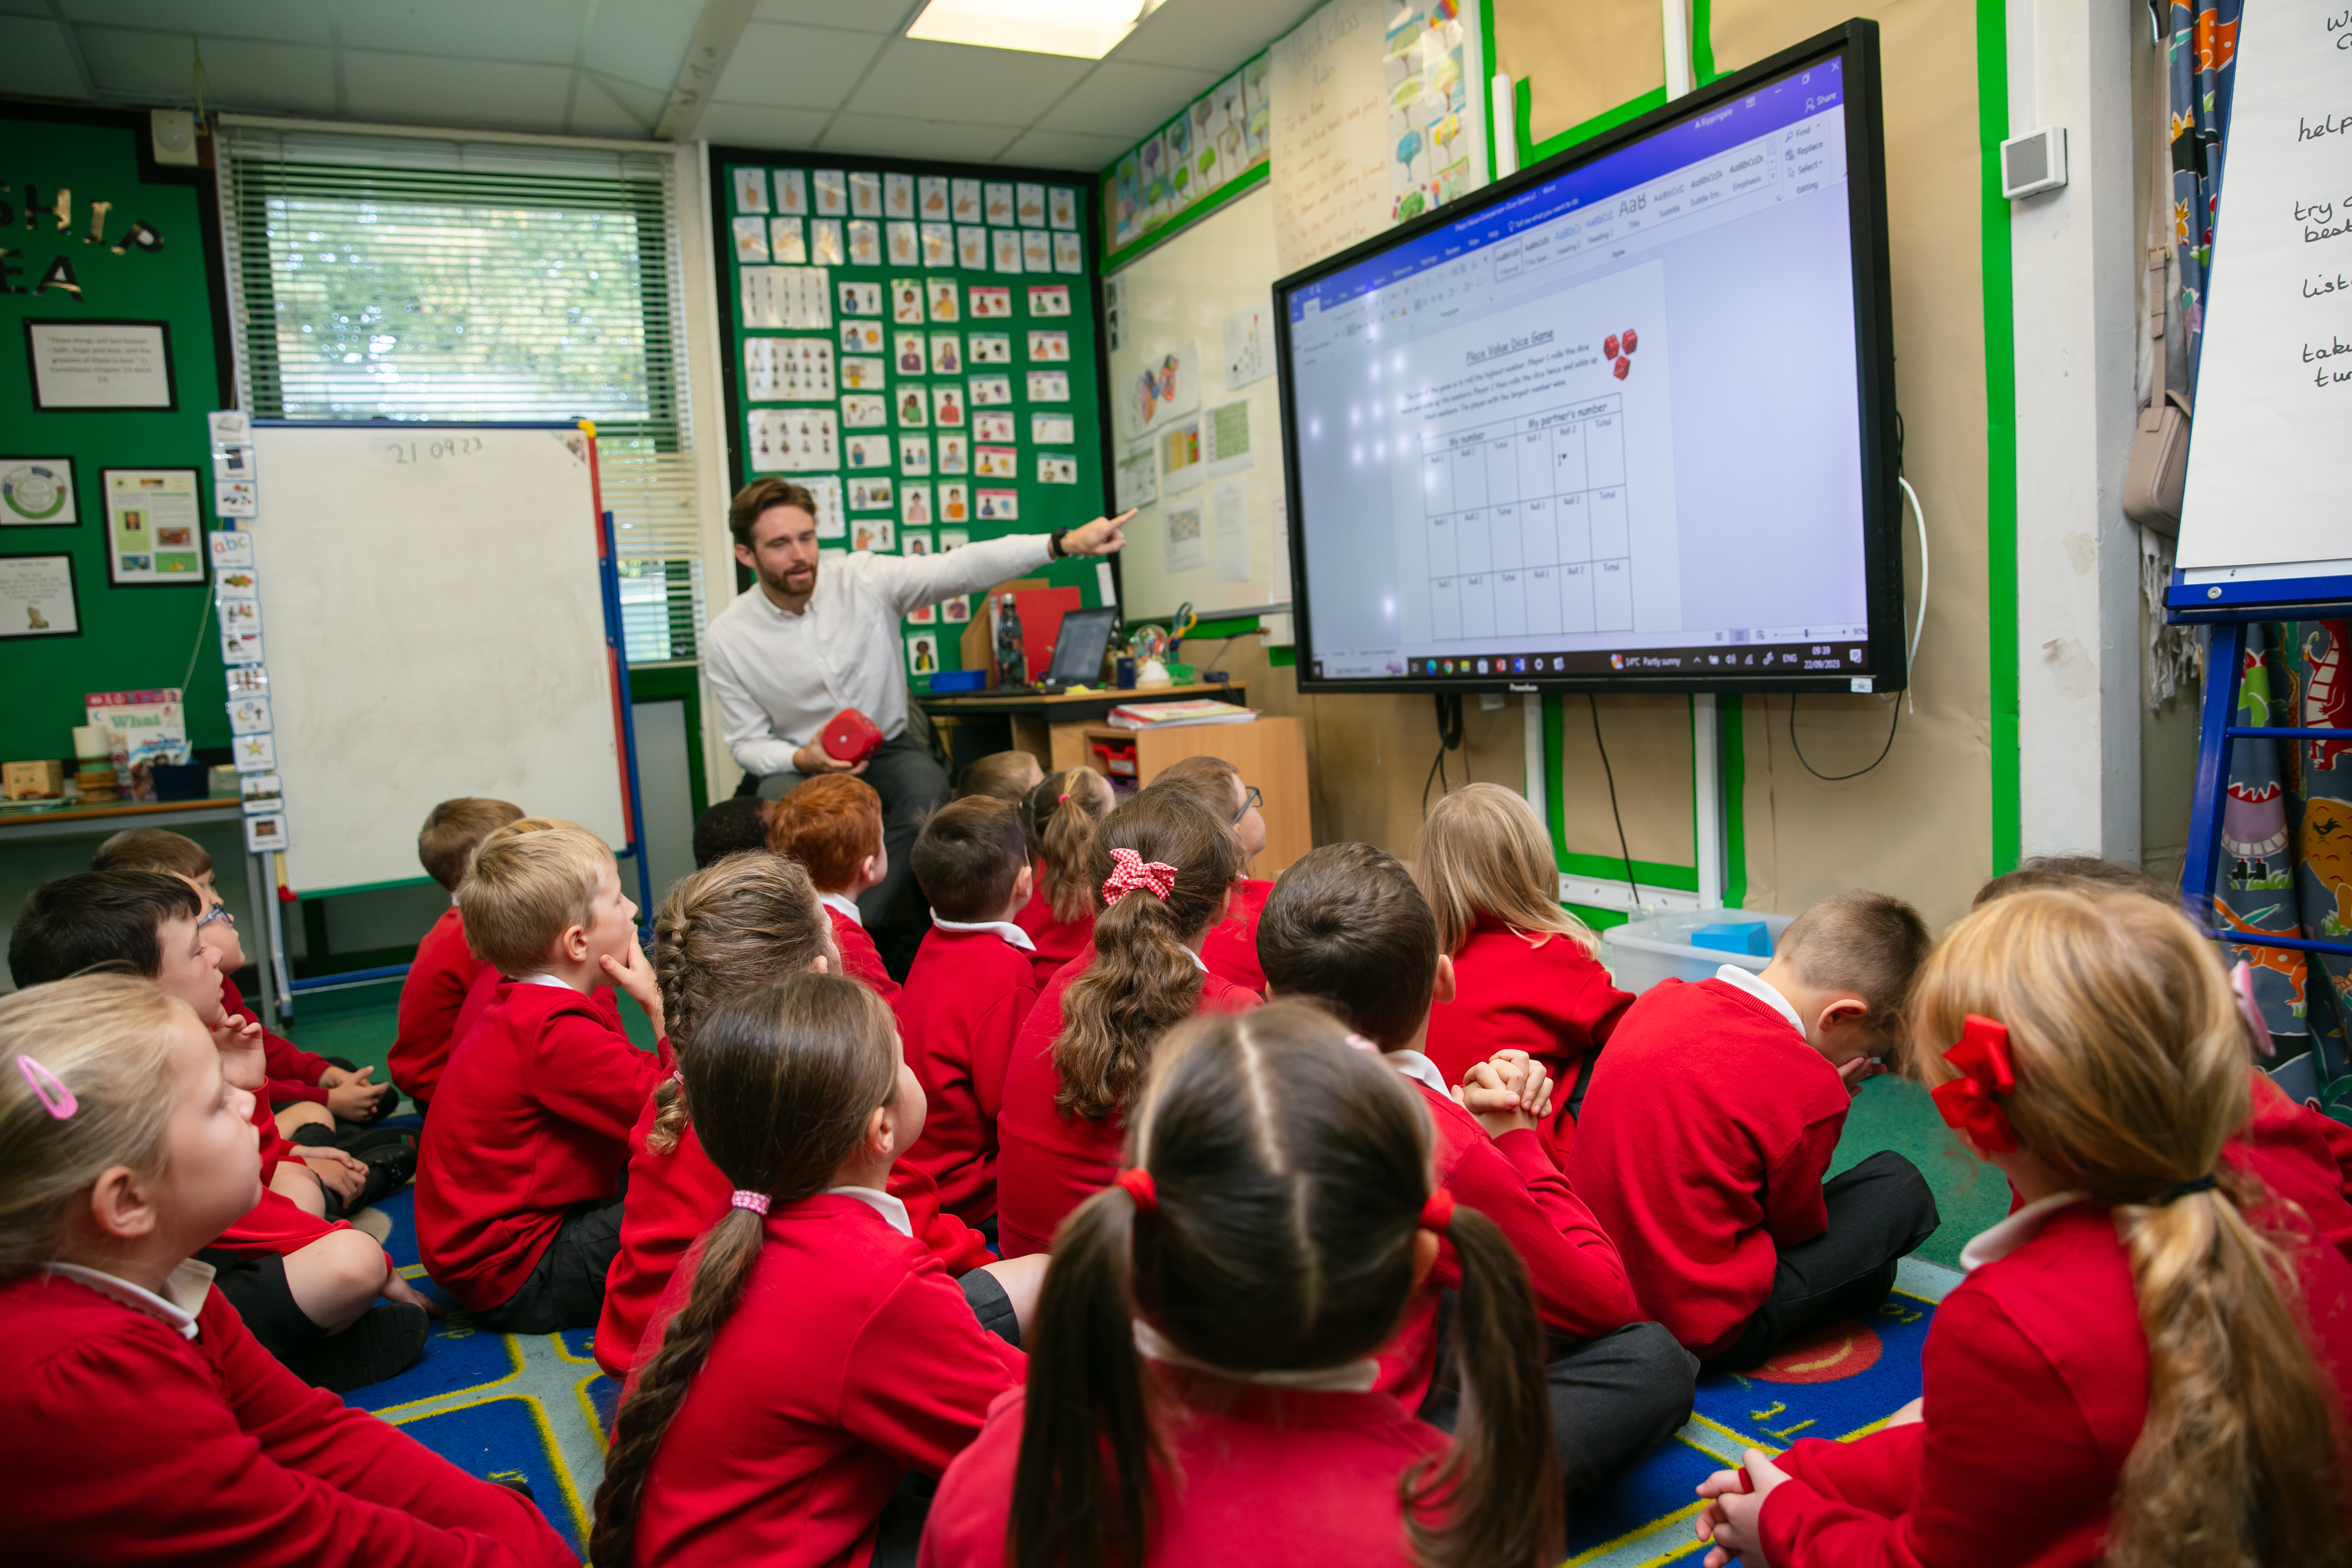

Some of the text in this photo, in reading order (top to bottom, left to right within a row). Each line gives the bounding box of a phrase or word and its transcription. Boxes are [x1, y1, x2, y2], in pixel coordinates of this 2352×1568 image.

[1817, 91, 1837, 106] Share
[1796, 125, 1811, 138] Find
[1796, 141, 1824, 156] Replace
[1798, 161, 1818, 175] Select
[1732, 175, 1761, 192] Emphasis
[1796, 181, 1818, 195] Editing
[1659, 205, 1680, 218] Subtitle
[2295, 201, 2332, 224] try
[2303, 274, 2352, 298] list
[1466, 329, 1554, 362] Place Value Dice Game
[1527, 356, 1545, 367] Player
[1550, 349, 1564, 359] rolls
[1565, 347, 1575, 356] the
[1576, 342, 1589, 353] dice
[1533, 370, 1545, 380] dice
[1546, 366, 1562, 375] twice
[1563, 360, 1574, 372] and
[1574, 358, 1589, 369] adds
[1590, 356, 1598, 367] up
[1510, 387, 1530, 400] largest
[1531, 382, 1551, 393] number
[1527, 402, 1608, 431] My partner's number
[1596, 416, 1612, 429] Total
[1560, 426, 1571, 436] Roll
[1449, 431, 1486, 449] My number
[1526, 434, 1538, 443] Roll
[1563, 496, 1575, 506] Roll
[1599, 489, 1616, 500] Total
[1530, 502, 1541, 511] Roll
[213, 536, 248, 554] abc
[1534, 569, 1545, 578] Roll
[1568, 566, 1579, 575] Roll
[1603, 561, 1620, 572] Total
[1642, 656, 1661, 669] Partly
[1661, 658, 1681, 668] sunny
[1782, 653, 1798, 663] ENG
[1804, 659, 1841, 670] 22/09/2023
[110, 713, 160, 728] What
